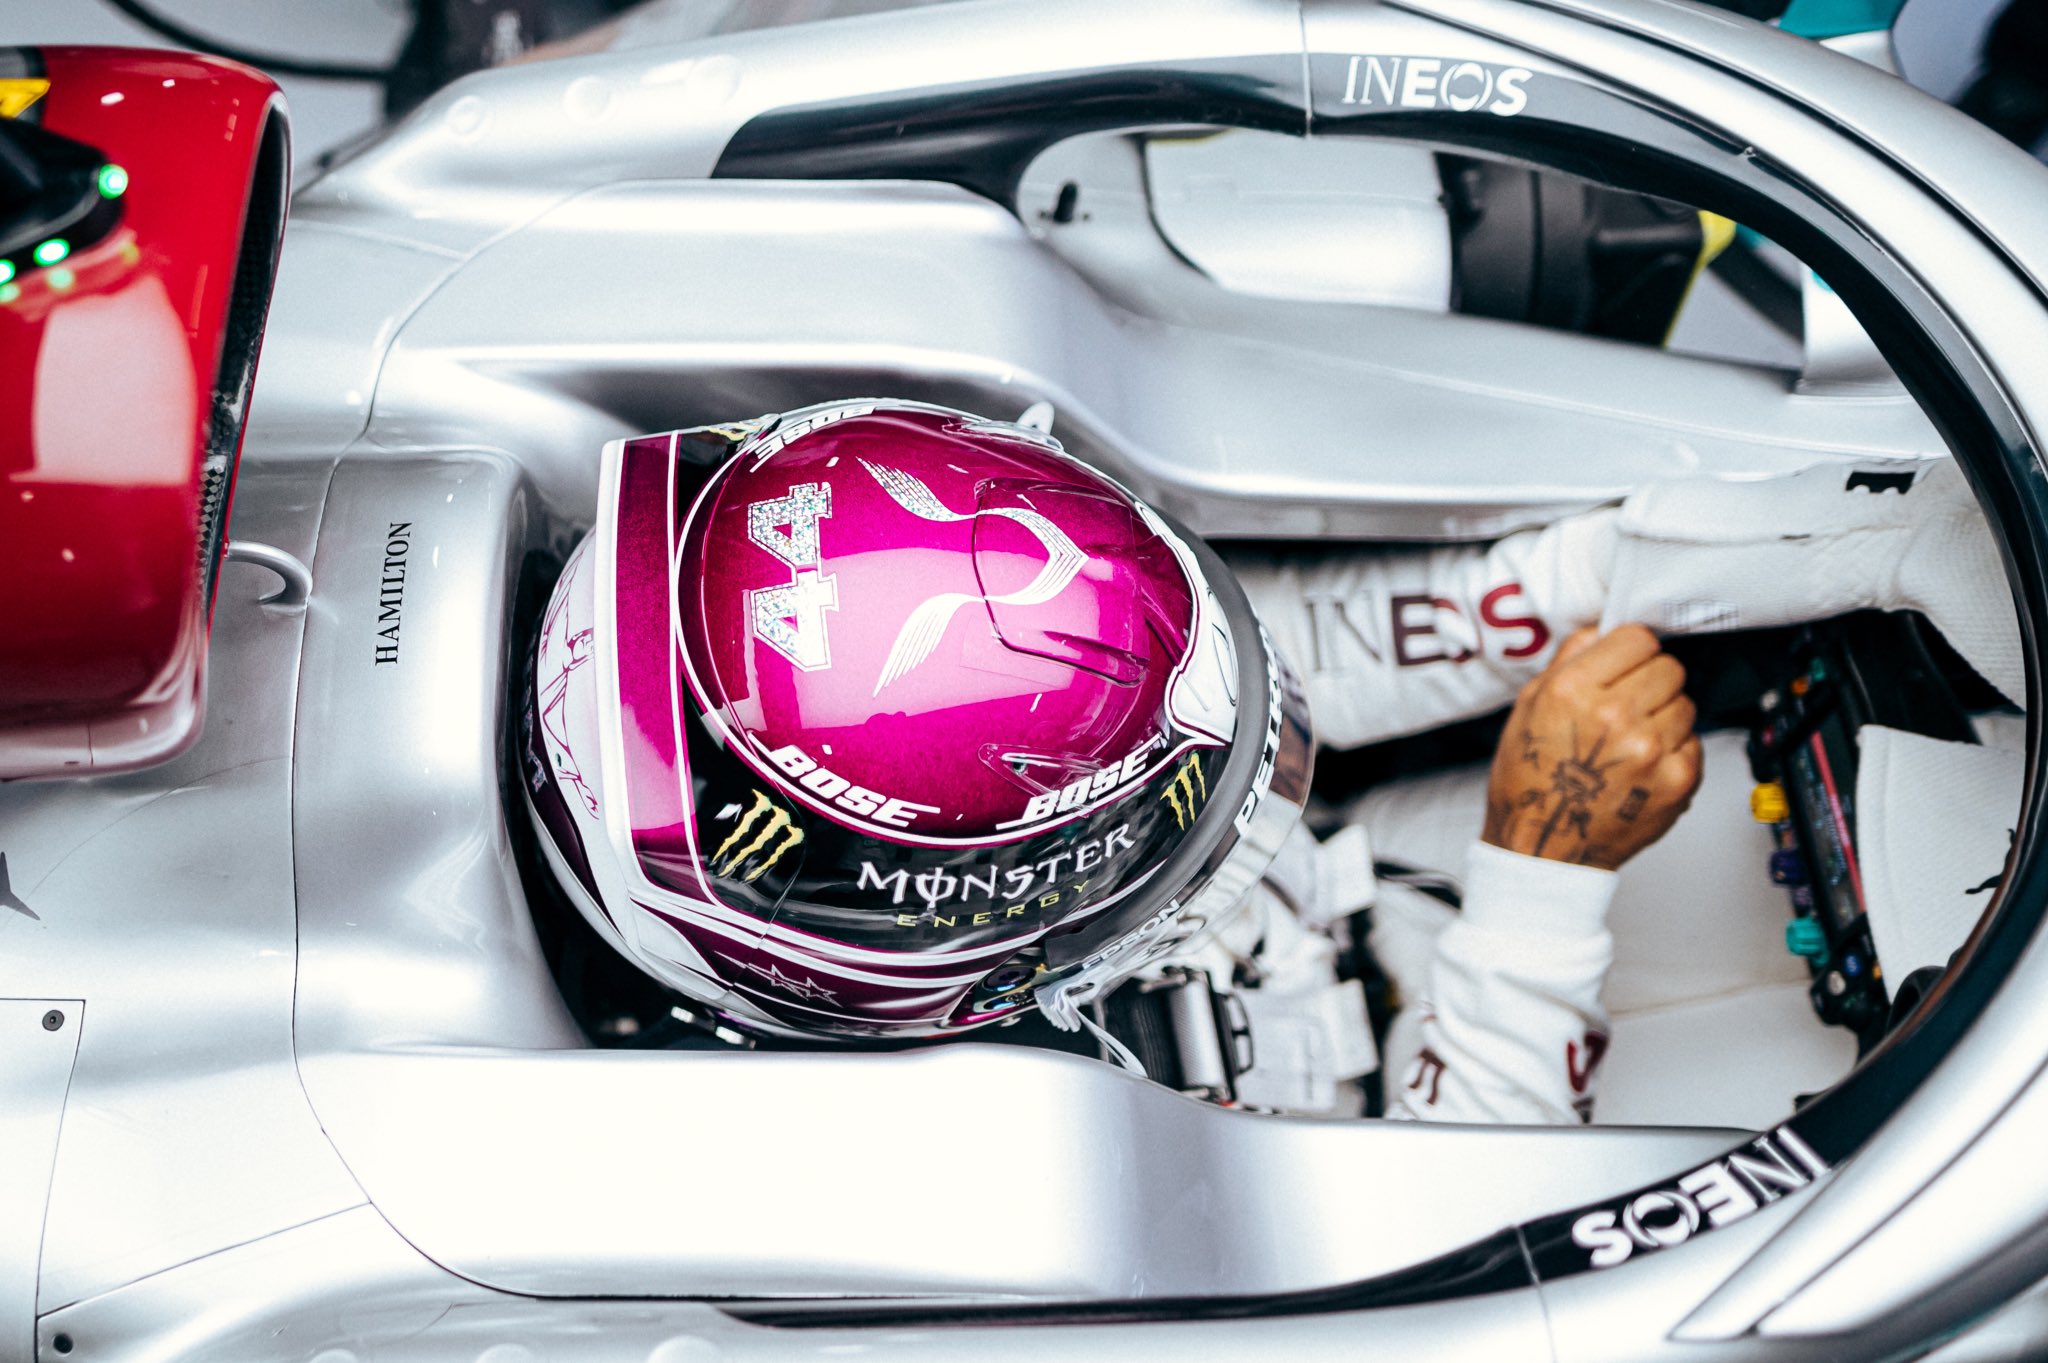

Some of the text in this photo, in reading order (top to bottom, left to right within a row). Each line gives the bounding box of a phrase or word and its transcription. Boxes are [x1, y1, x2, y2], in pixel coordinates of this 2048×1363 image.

[1342, 55, 1533, 116] INEOS
[750, 406, 876, 473] BOSE
[375, 522, 413, 665] HAMILTON
[748, 482, 839, 672] 44
[748, 731, 941, 828] BOSE
[996, 732, 1163, 832] BOSE
[856, 823, 1136, 909] MONSTER
[897, 880, 1089, 928] ENERGY
[1573, 1127, 1831, 1268] INEOS
